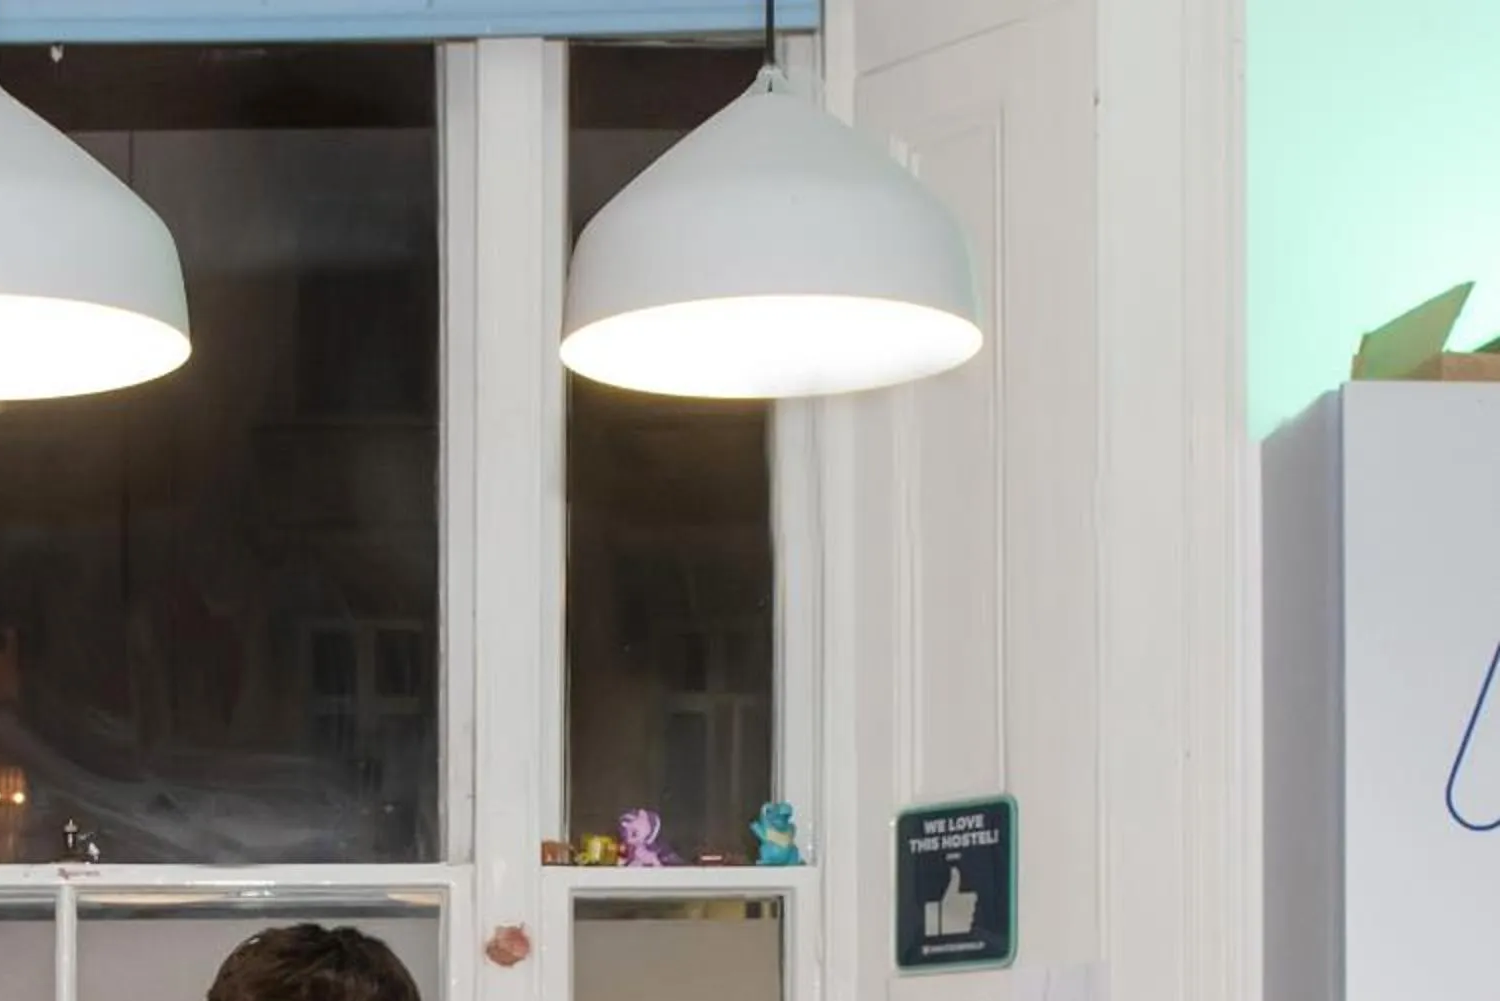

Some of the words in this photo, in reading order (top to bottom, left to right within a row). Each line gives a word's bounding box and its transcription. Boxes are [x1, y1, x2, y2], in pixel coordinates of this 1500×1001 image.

[924, 819, 946, 834] WE
[947, 813, 984, 832] LOVE
[909, 837, 940, 854] THIS
[941, 829, 999, 849] HOSTEL!
